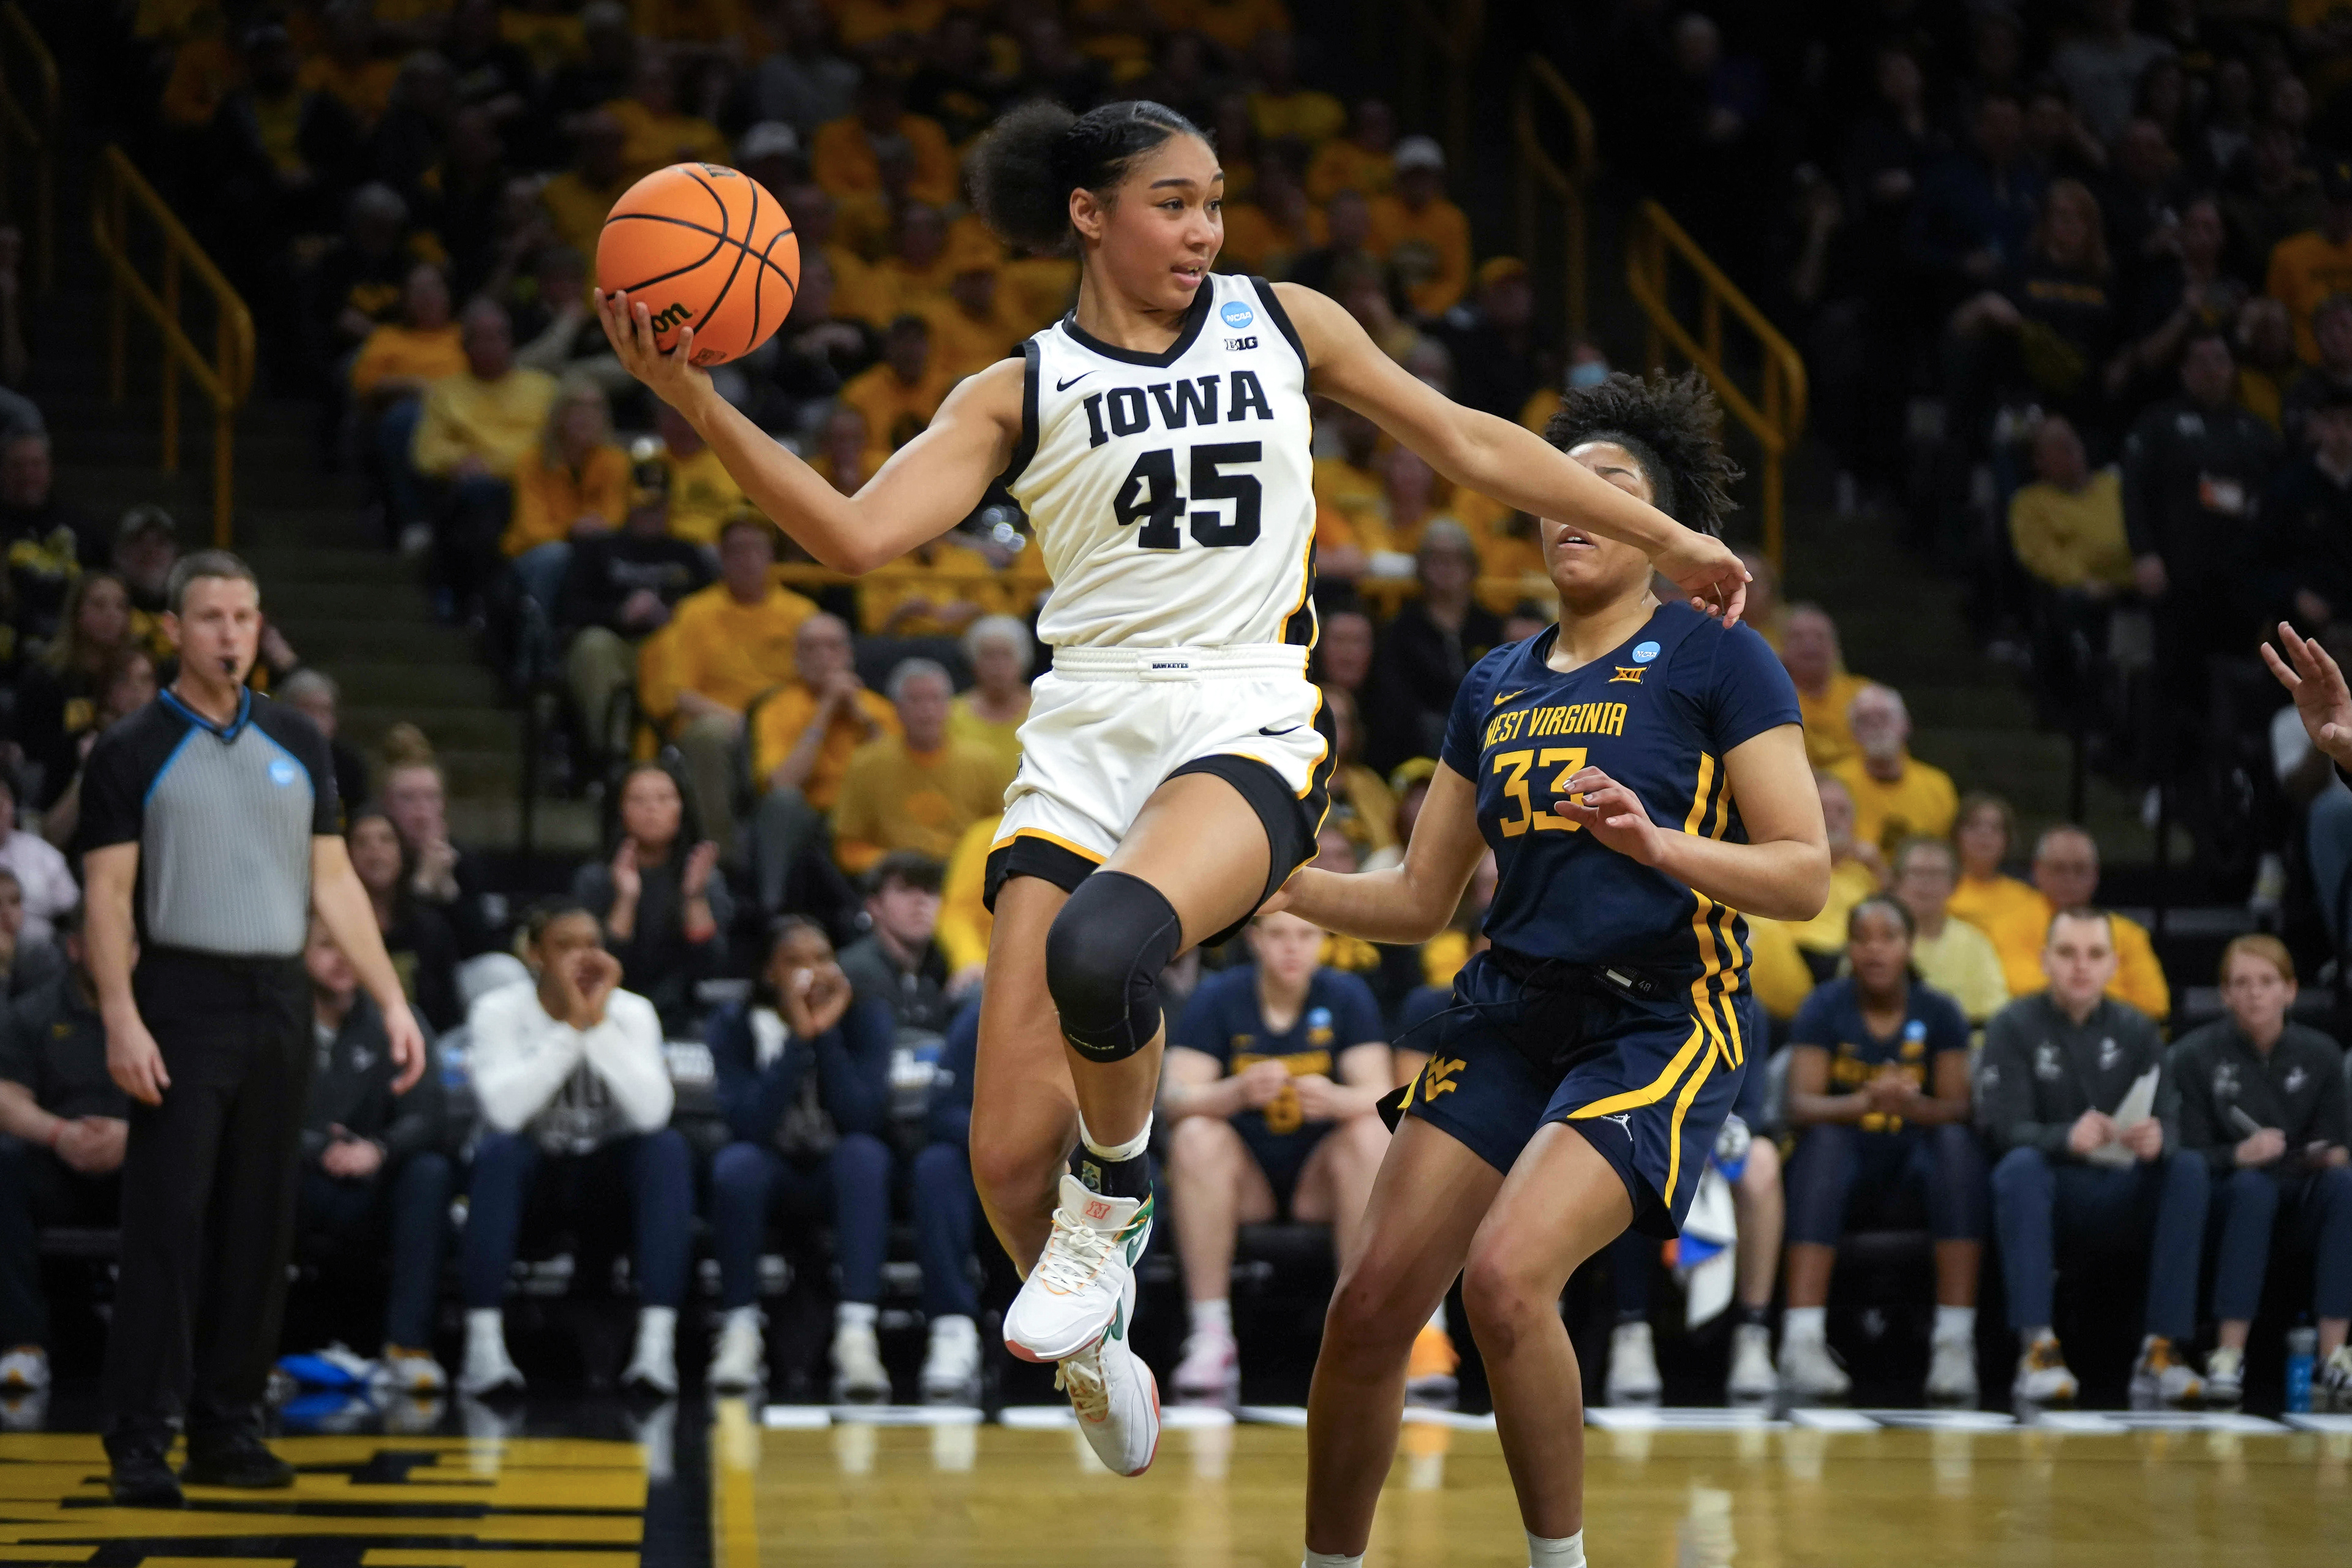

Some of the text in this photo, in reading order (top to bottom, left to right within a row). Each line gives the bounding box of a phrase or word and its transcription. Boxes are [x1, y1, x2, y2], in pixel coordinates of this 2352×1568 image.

[1226, 311, 1252, 322] NCAA
[1084, 371, 1273, 448] IOWA
[1113, 441, 1262, 549] 45
[1483, 702, 1627, 751] WEST VIRGINIA
[1493, 747, 1588, 837] 33
[1638, 980, 1651, 992] 48
